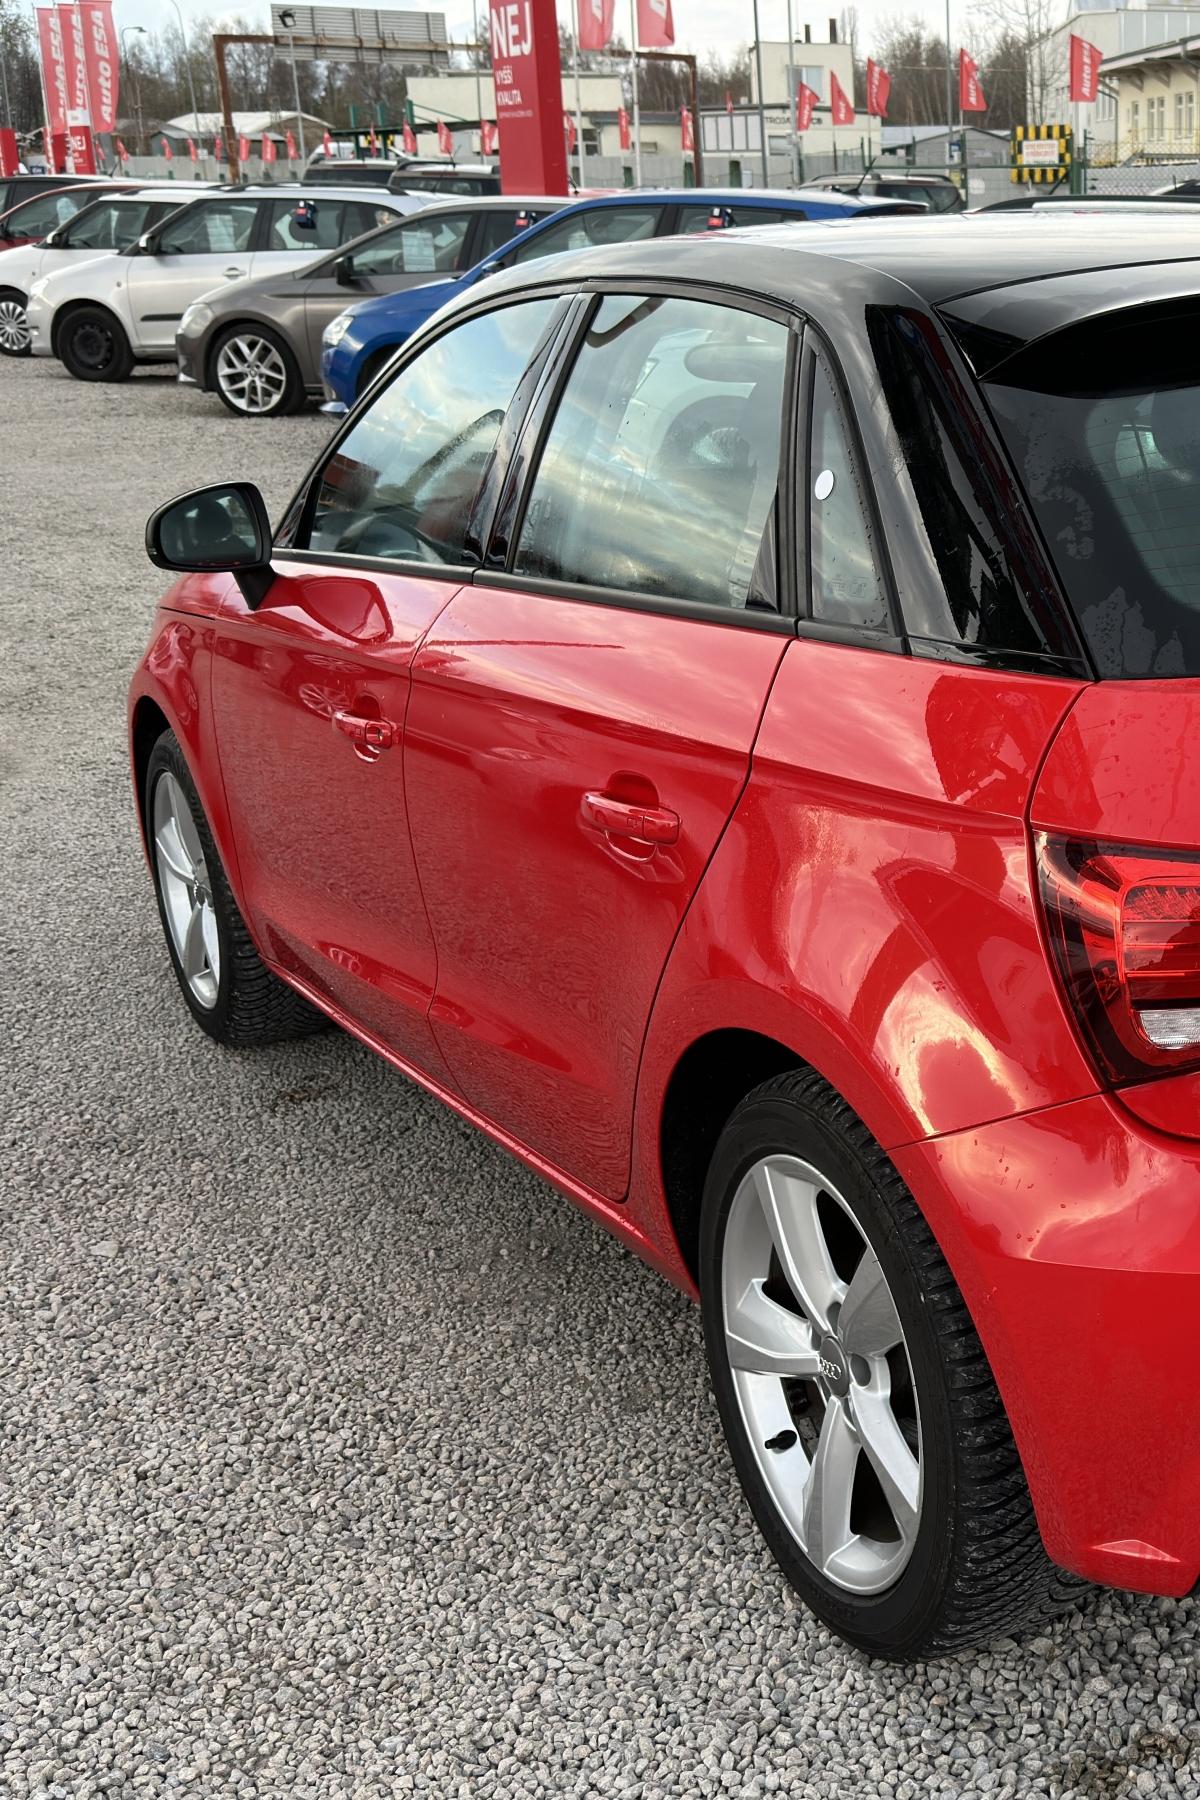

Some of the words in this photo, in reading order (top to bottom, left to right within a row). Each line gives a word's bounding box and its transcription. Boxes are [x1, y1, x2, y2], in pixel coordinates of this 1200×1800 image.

[91, 10, 110, 58] ESA
[491, 1, 533, 60] NEJ
[99, 62, 112, 124] Auto
[497, 89, 523, 106] KVALITA
